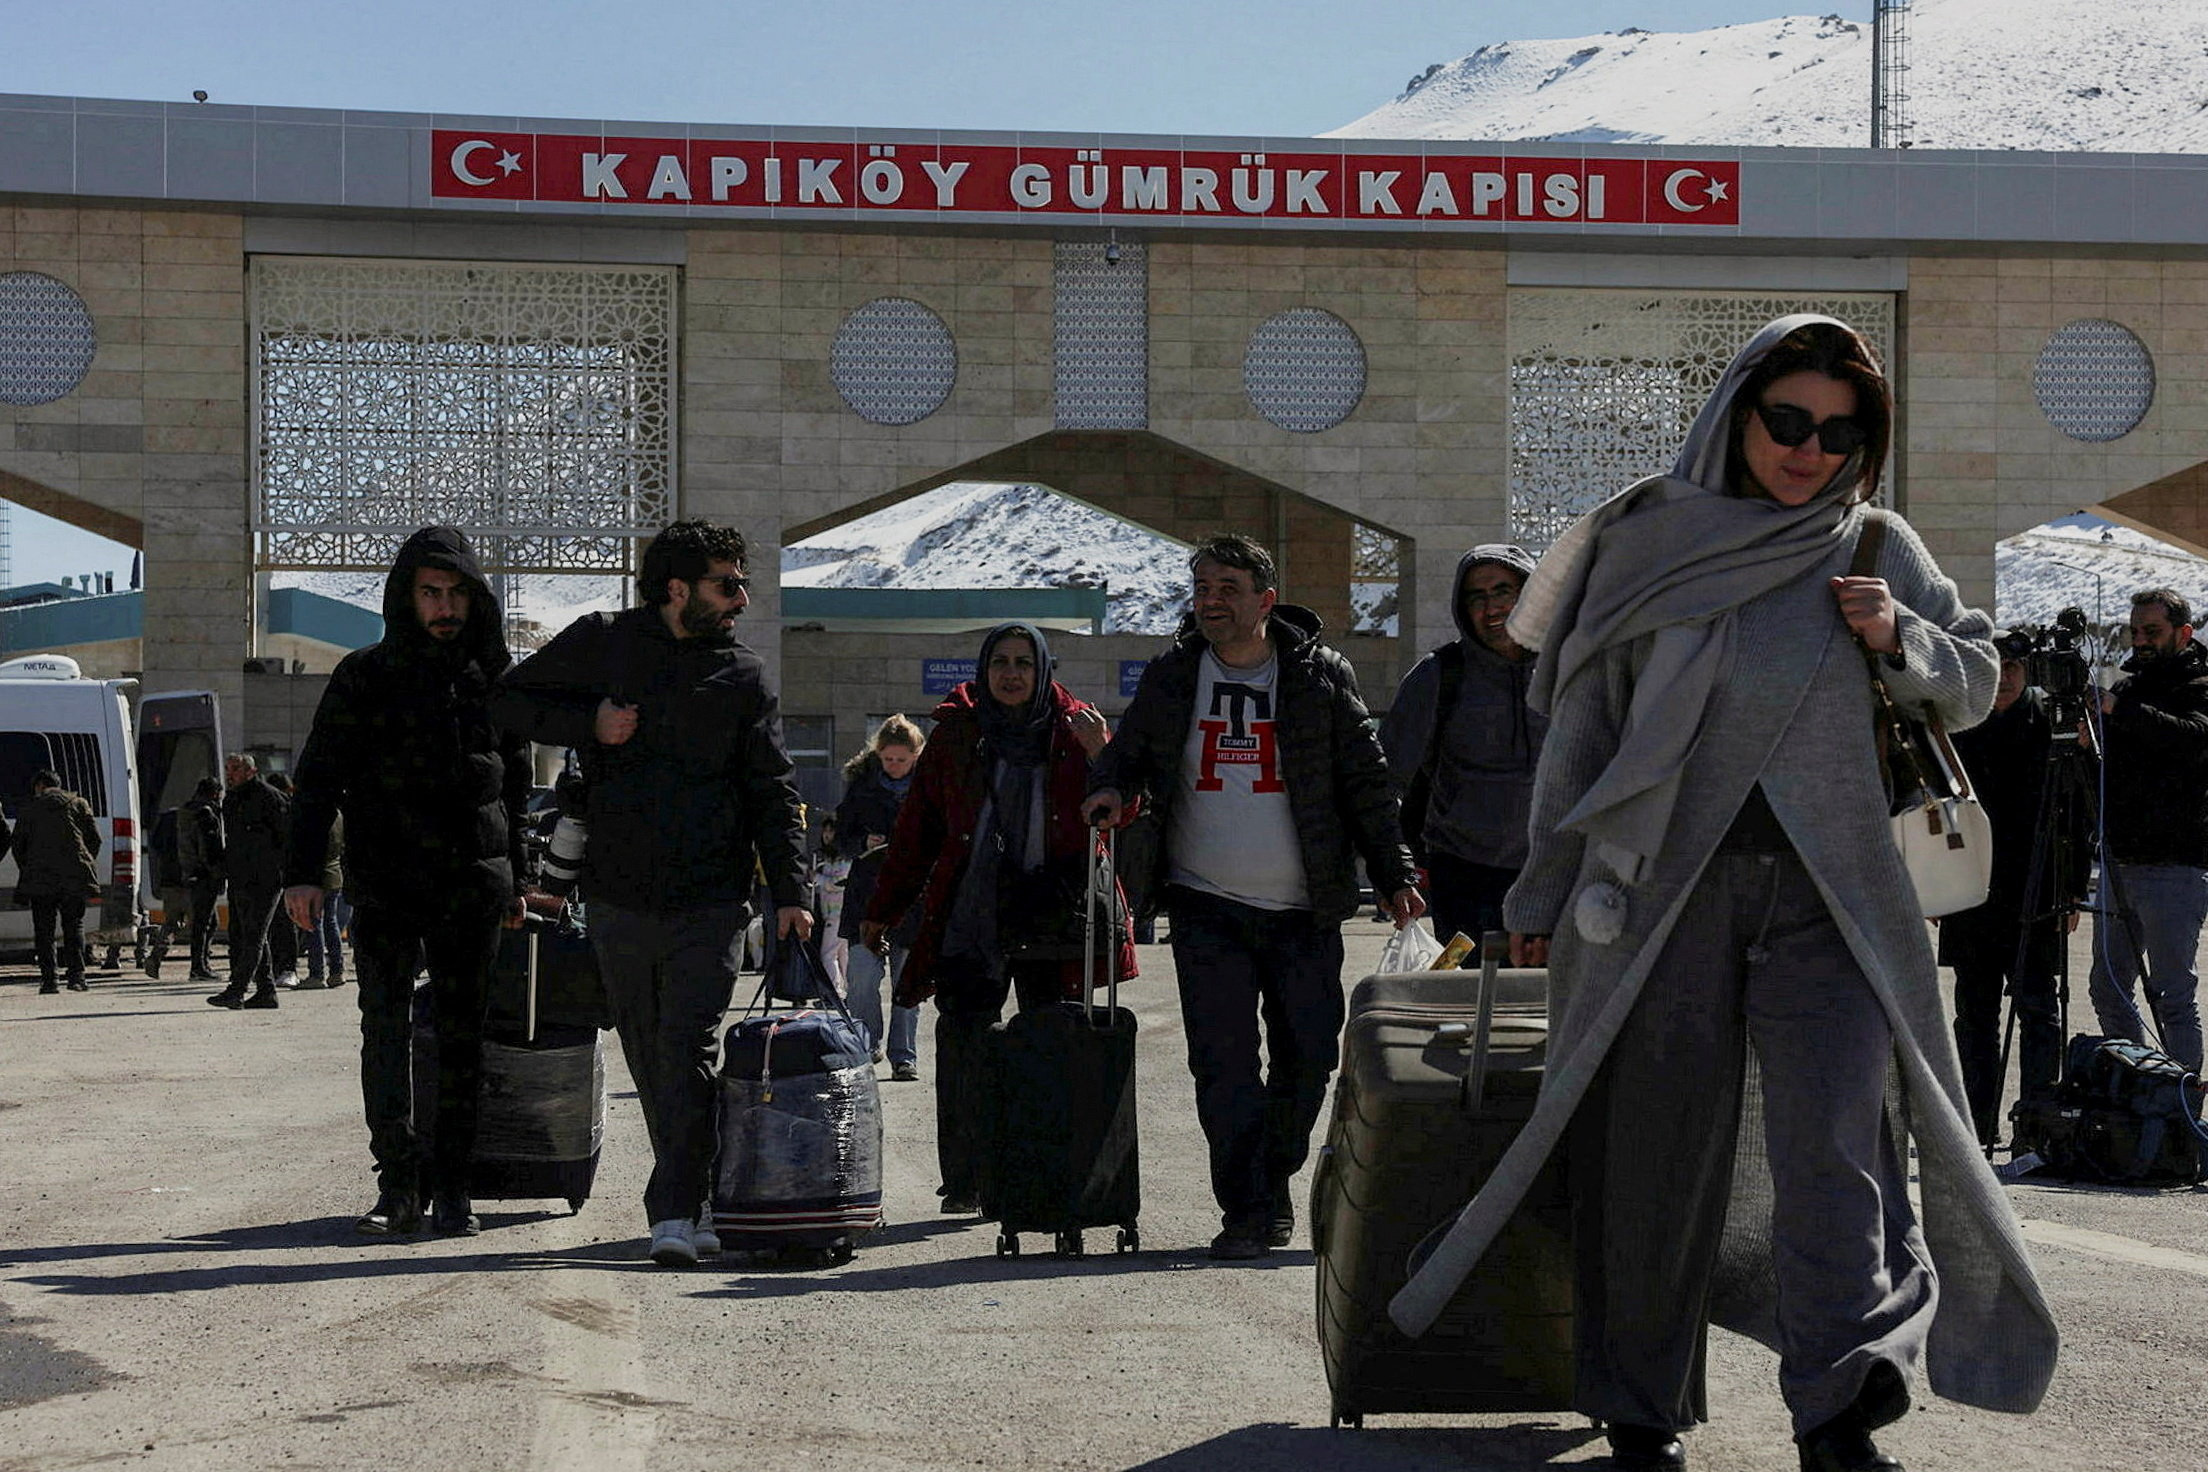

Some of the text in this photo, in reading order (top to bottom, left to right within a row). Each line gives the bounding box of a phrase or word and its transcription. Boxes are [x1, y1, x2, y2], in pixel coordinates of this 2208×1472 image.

[582, 146, 1605, 218] KAPIKÖY GÜMRÜK KAPISI
[1223, 738, 1254, 747] TOMMY
[1217, 752, 1260, 761] HILFIGER
